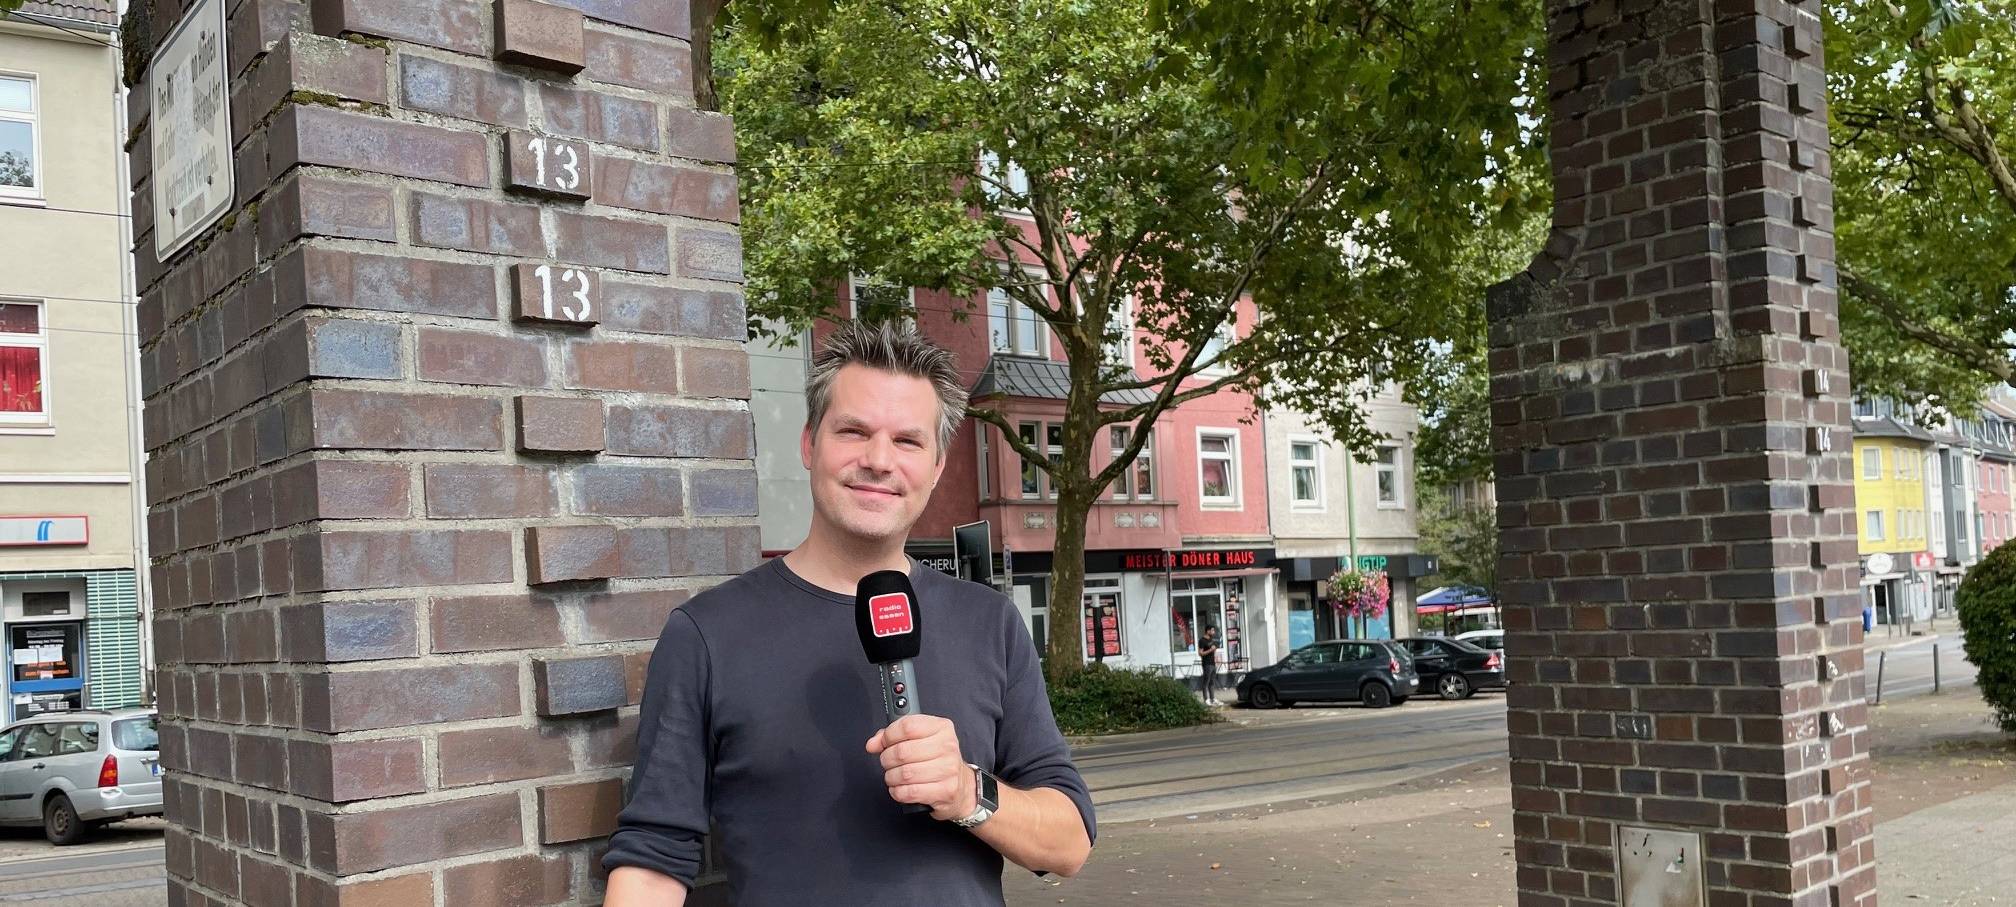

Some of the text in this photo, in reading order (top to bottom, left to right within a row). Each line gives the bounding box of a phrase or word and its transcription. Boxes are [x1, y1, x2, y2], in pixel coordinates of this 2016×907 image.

[528, 138, 579, 189] 13
[535, 265, 590, 321] 13
[1818, 426, 1831, 451] 14
[1126, 551, 1255, 568] MEISTER DÖNER HAUS
[879, 604, 901, 612] radio
